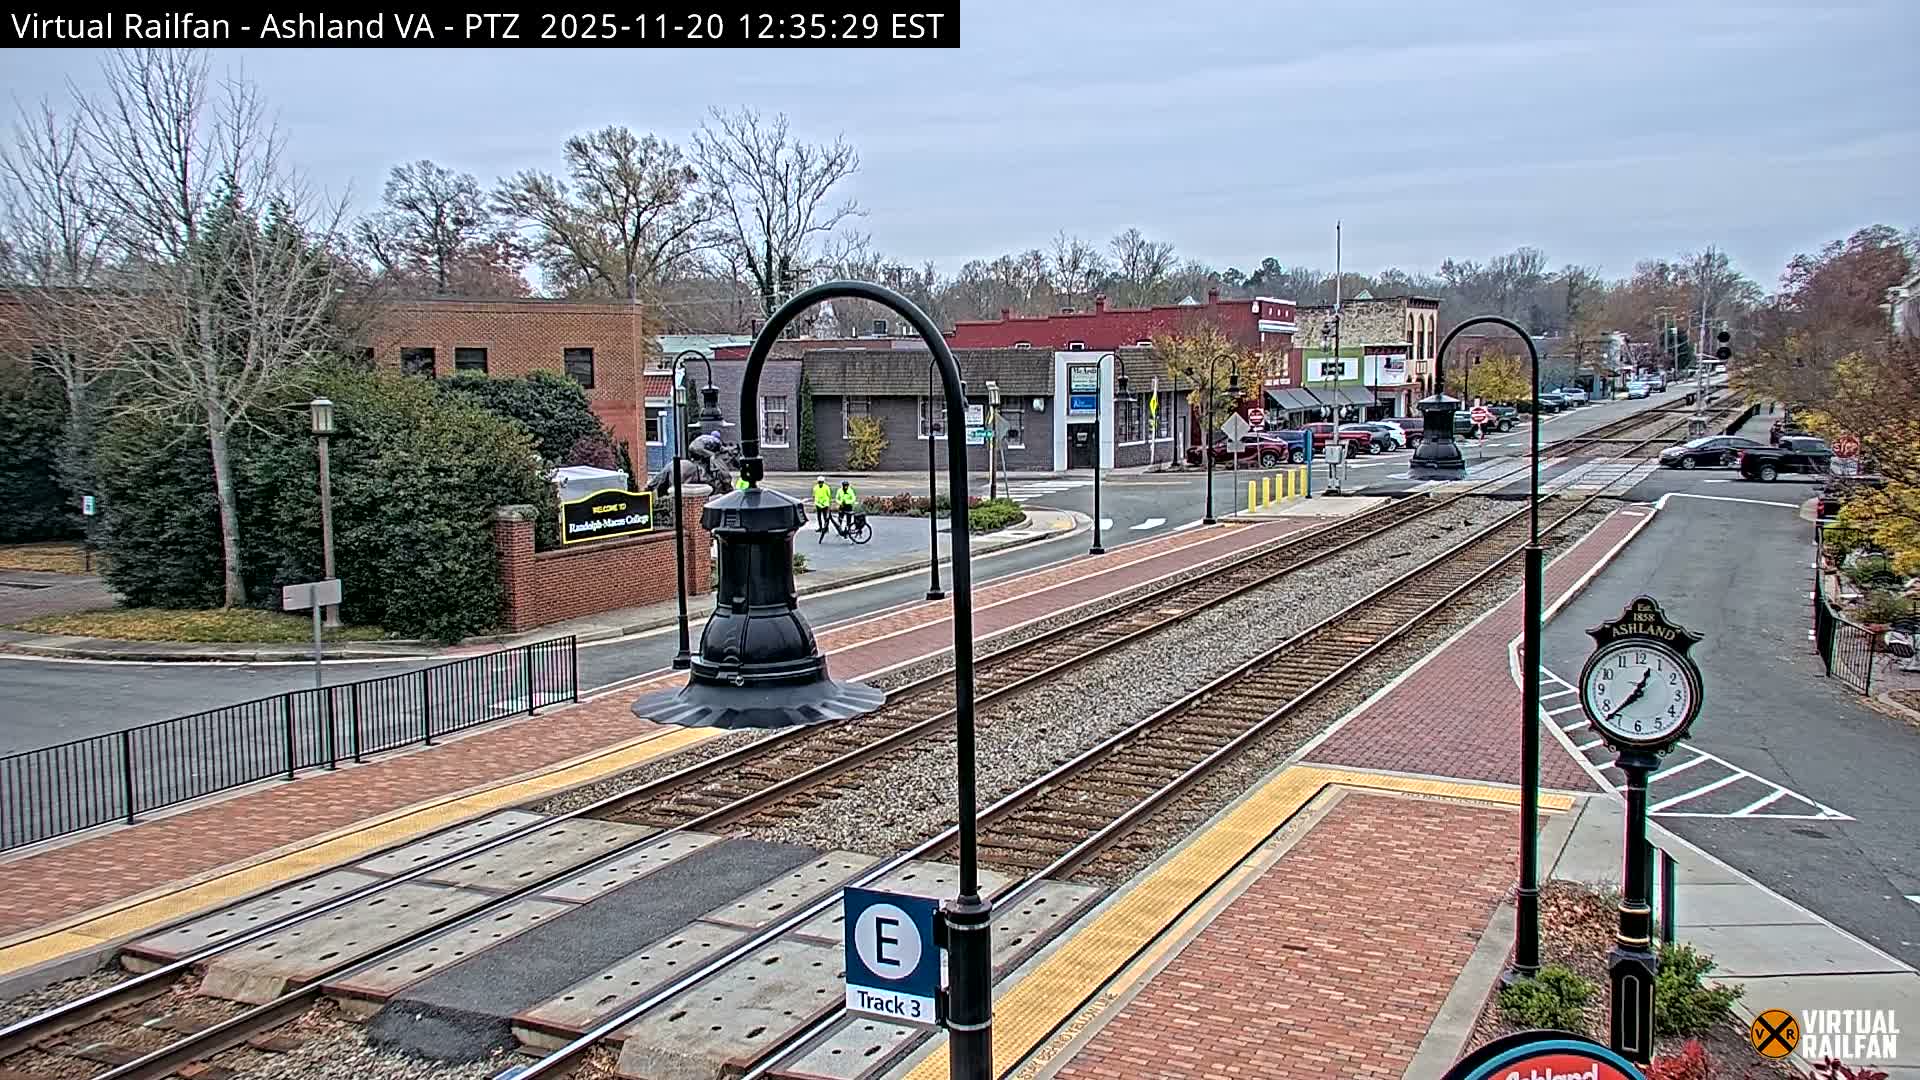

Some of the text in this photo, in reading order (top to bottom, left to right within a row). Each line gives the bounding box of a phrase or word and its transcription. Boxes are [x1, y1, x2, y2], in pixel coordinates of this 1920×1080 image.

[1612, 622, 1676, 641] ASHLAND
[1618, 656, 1627, 668] 11
[1635, 653, 1647, 665] 12
[1657, 659, 1662, 671] 1
[1602, 668, 1614, 681] 10
[1669, 672, 1677, 686] 2
[1598, 683, 1605, 696] 9
[1675, 690, 1682, 702] 3
[1602, 699, 1611, 712] 8
[1668, 704, 1676, 718] 4
[1615, 713, 1623, 727] 7
[1634, 720, 1642, 732] 6
[1654, 717, 1662, 730] 5
[875, 916, 900, 966] E
[857, 990, 921, 1018] Track 3
[1505, 1063, 1598, 1080] Ahlnd
